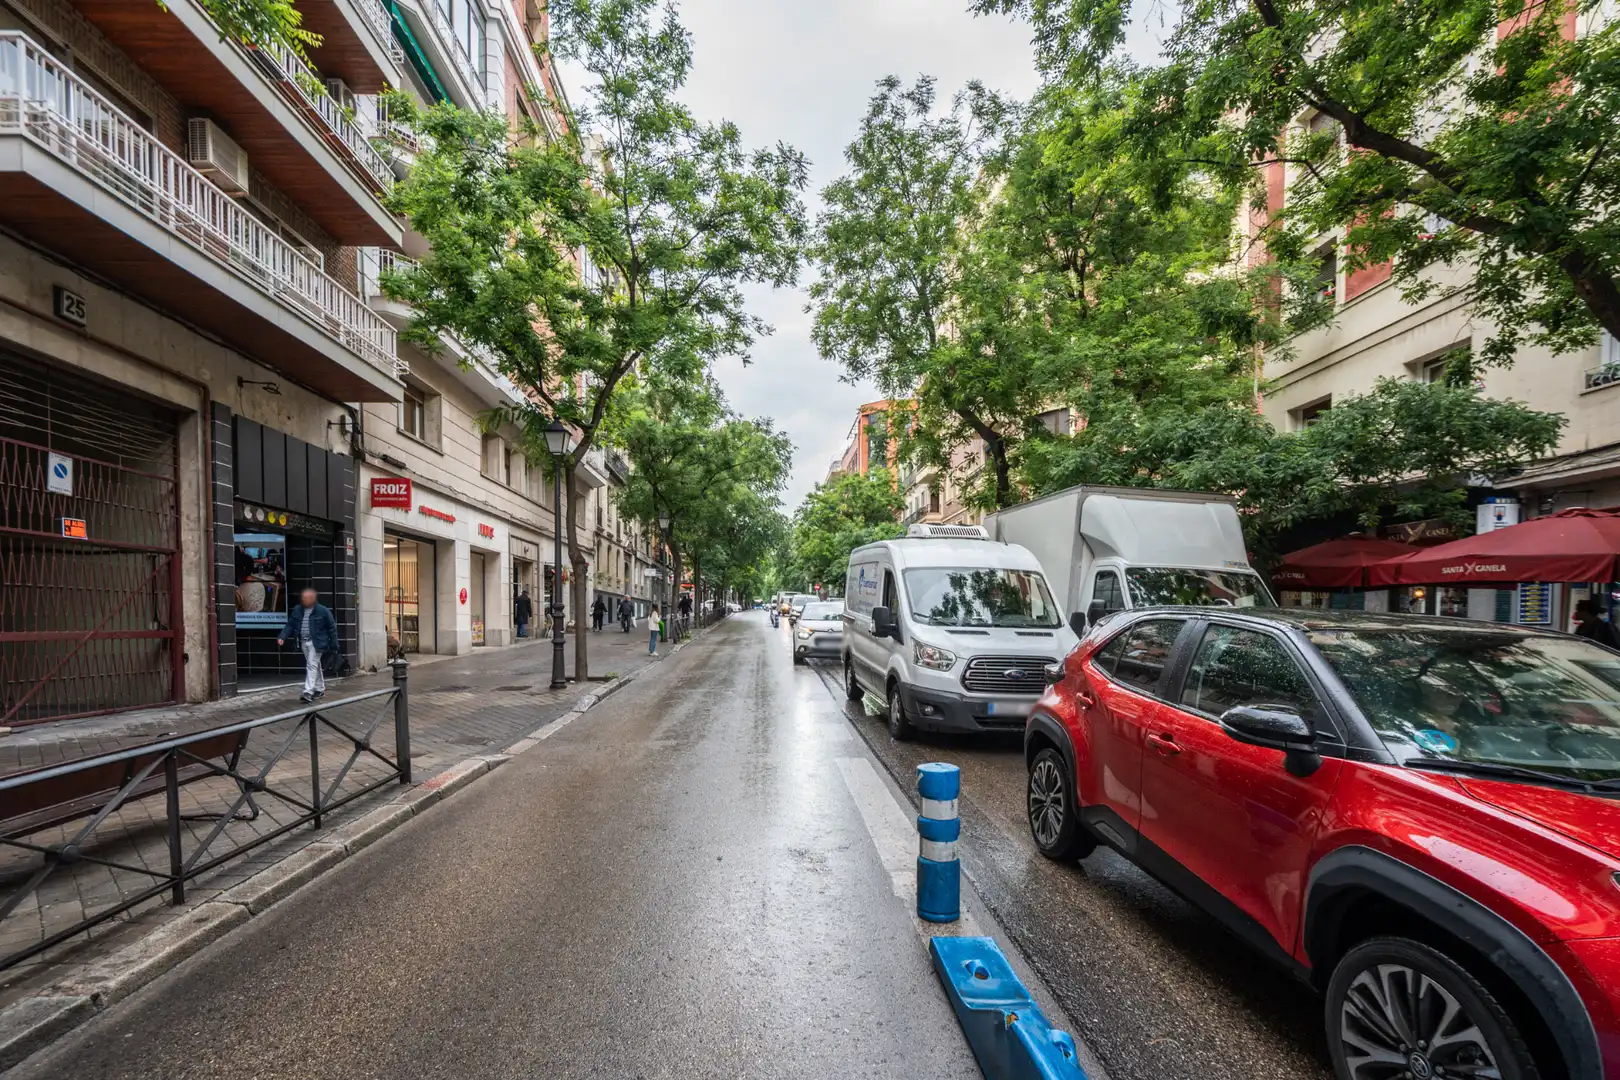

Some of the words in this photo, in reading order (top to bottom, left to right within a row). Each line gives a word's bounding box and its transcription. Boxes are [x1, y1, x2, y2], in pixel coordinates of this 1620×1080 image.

[65, 295, 85, 318] 25
[373, 483, 408, 495] FROIZ
[1441, 566, 1464, 574] SANTA
[1475, 564, 1506, 572] CANELA
